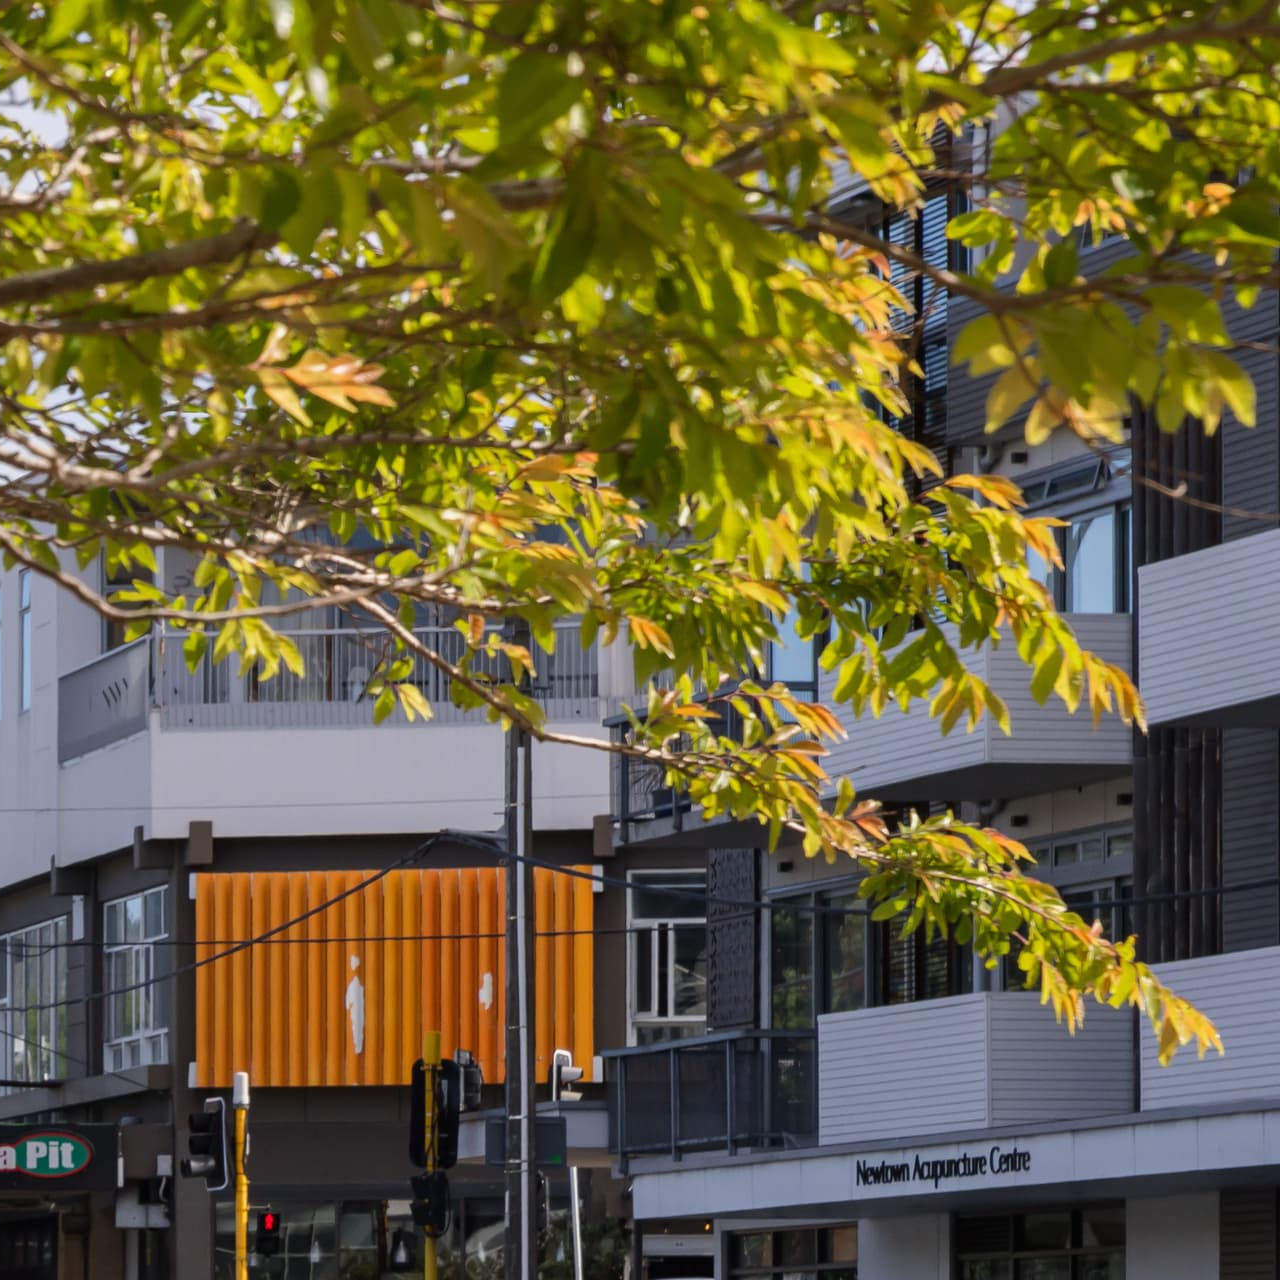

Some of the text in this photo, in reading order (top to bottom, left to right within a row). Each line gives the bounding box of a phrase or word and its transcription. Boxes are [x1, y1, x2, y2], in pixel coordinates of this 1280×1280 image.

[25, 1140, 75, 1169] Pit
[856, 1146, 1031, 1189] Newtown Acupuncture Centre
